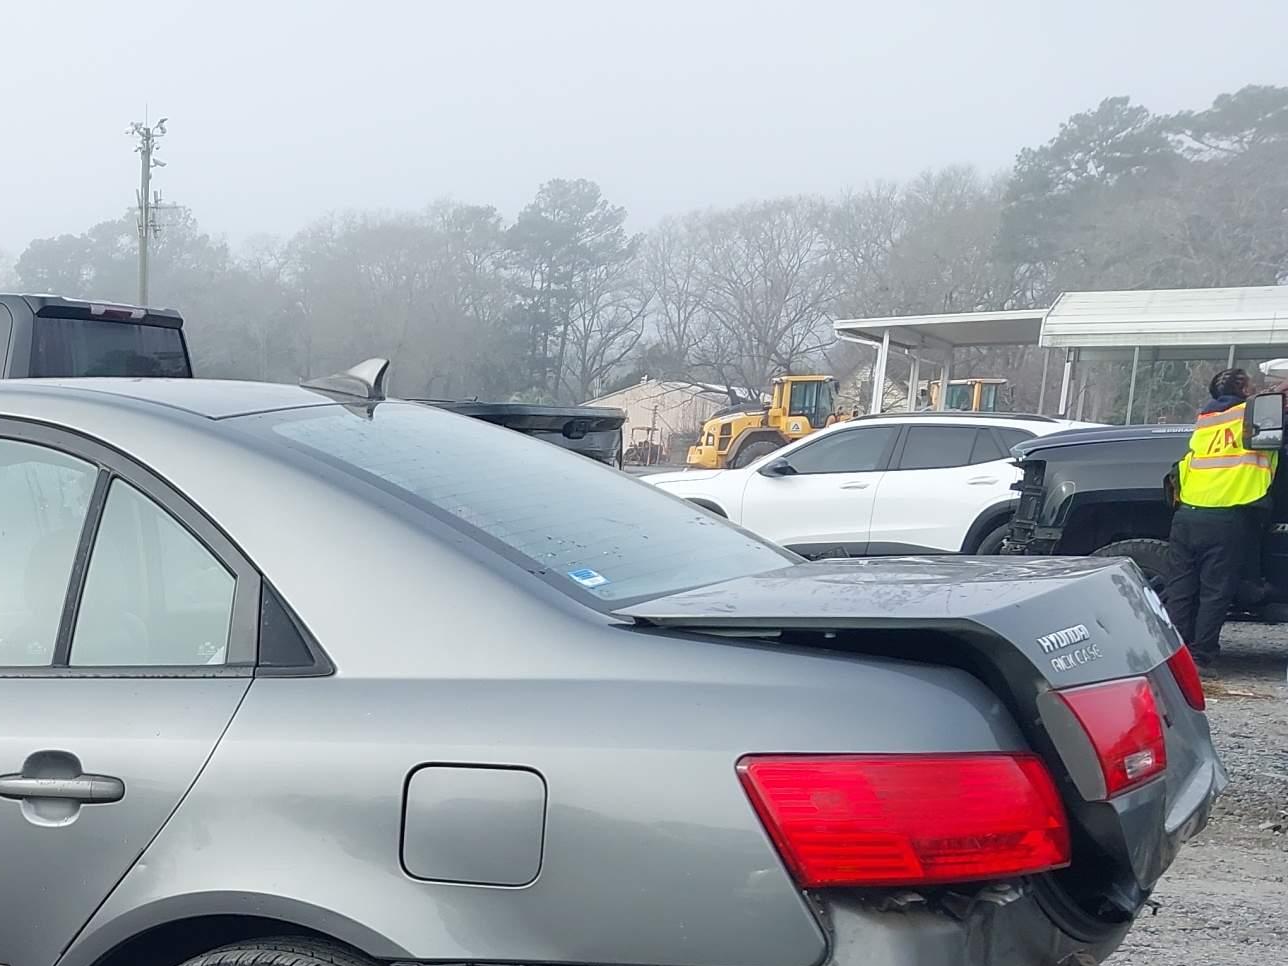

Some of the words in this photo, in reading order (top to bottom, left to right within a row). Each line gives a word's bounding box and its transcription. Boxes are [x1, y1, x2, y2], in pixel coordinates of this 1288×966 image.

[1036, 624, 1090, 653] HYUNDAI
[1050, 653, 1077, 673] RICK
[1074, 643, 1103, 665] CASE
